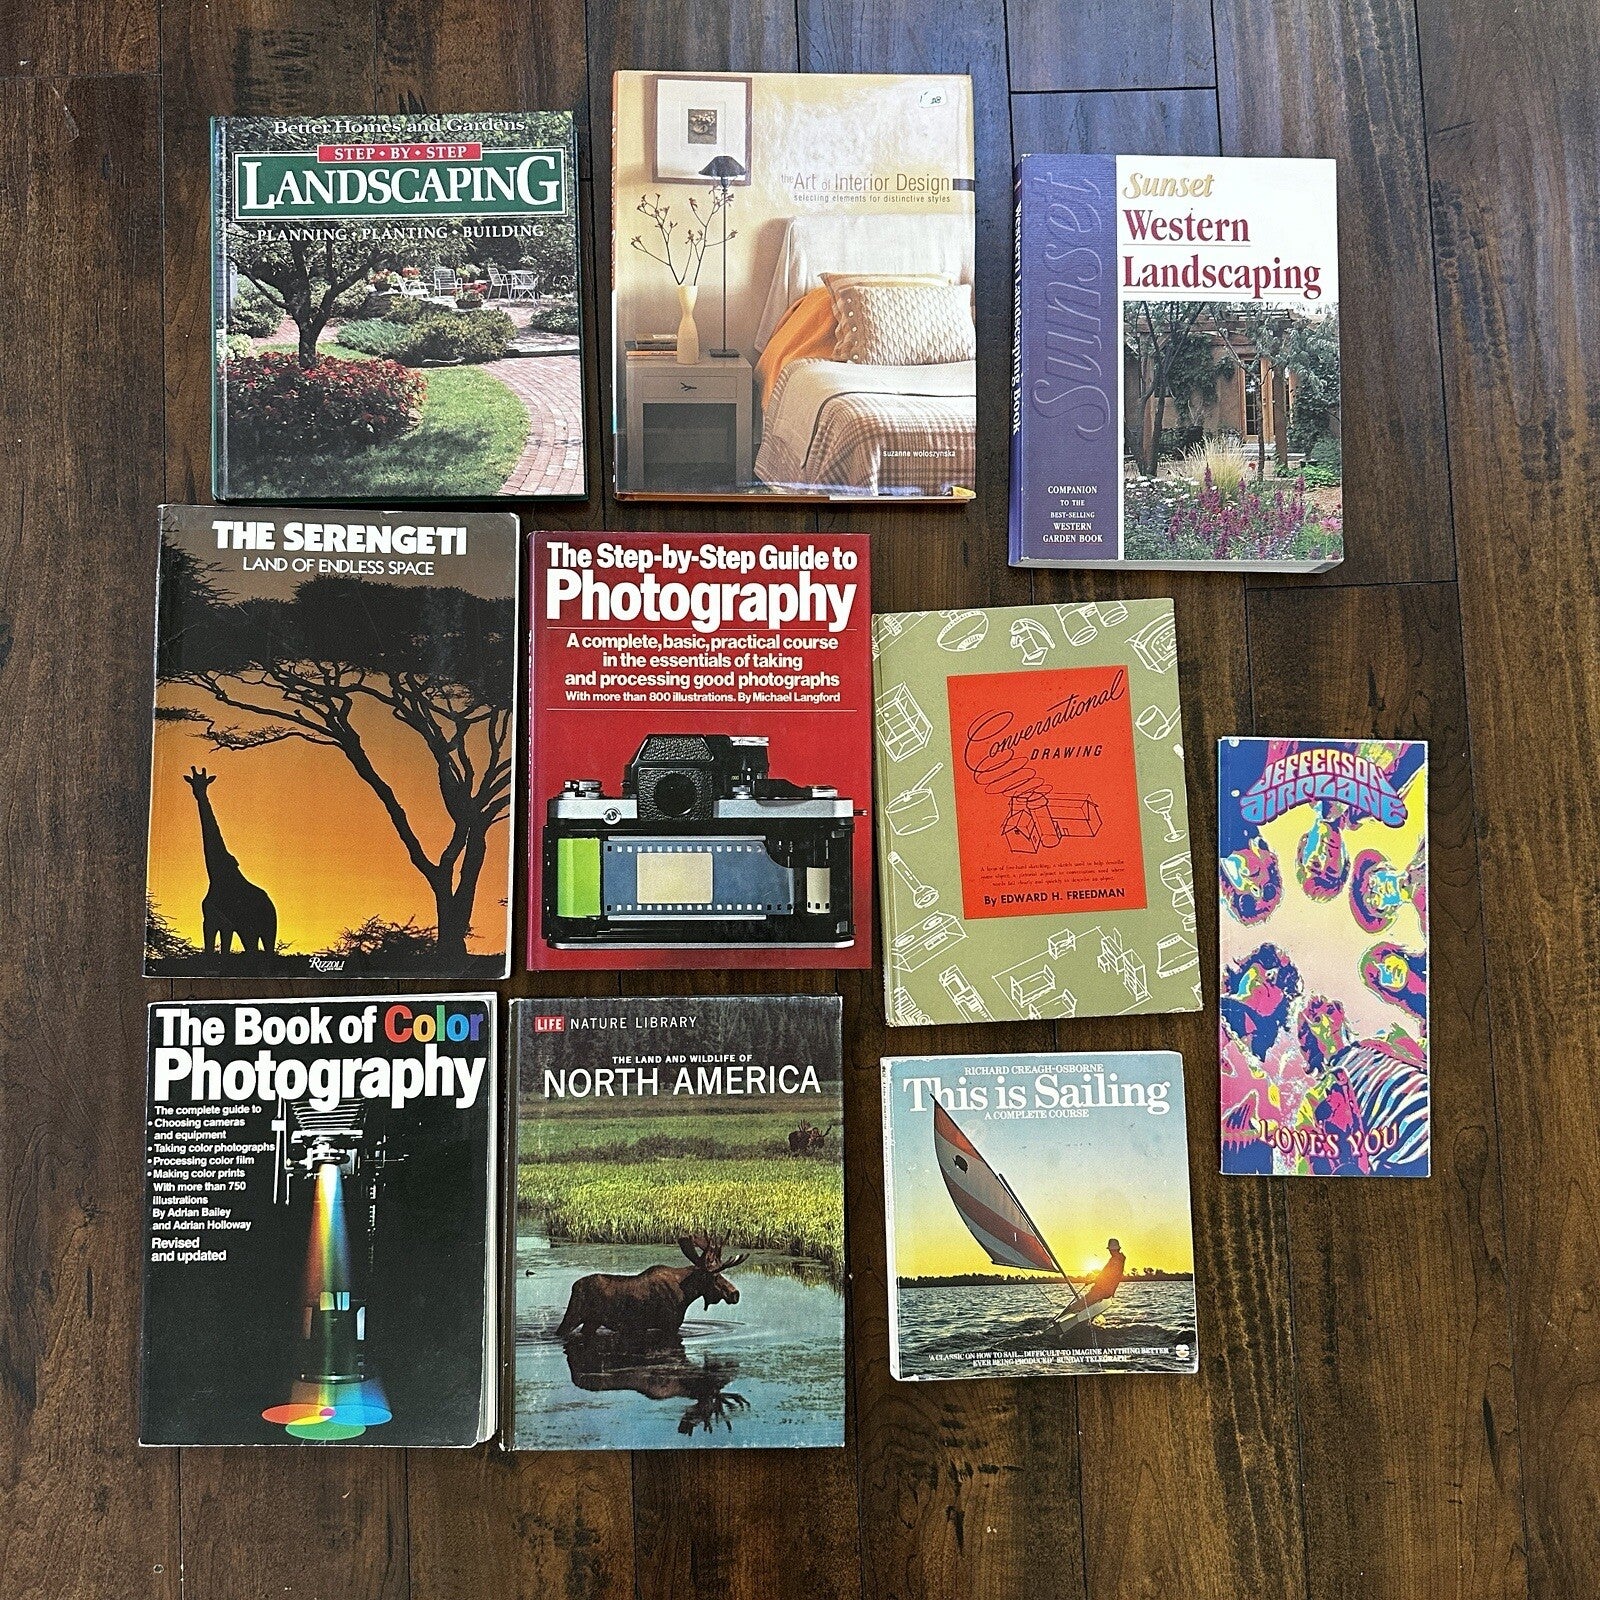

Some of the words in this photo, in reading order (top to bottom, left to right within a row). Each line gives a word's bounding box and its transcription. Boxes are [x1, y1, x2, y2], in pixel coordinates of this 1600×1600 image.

[274, 121, 331, 134] Better
[334, 120, 396, 134] Homes
[399, 120, 443, 133] and
[447, 118, 525, 132] Gardens
[334, 148, 376, 161] STEP
[391, 147, 411, 160] BY
[426, 146, 467, 159] STEP
[241, 156, 560, 210] LANDSCAPING
[781, 175, 794, 183] the
[794, 174, 816, 190] Art
[822, 180, 831, 190] of
[836, 174, 889, 190] Interior
[896, 174, 949, 194] Design
[1122, 173, 1215, 199] Sunset
[794, 195, 829, 203] selecting
[928, 195, 950, 203] styles
[1123, 208, 1250, 242] Western
[257, 229, 348, 241] PLANNING
[362, 228, 448, 240] PLANTING
[463, 225, 544, 238] BUILDING
[1123, 254, 1322, 299] Landscaping
[1048, 486, 1097, 494] COMPANION
[212, 521, 275, 550] THE
[284, 523, 467, 555] SERENGETI
[547, 542, 592, 568] The
[597, 543, 756, 574] Step-by-Step
[759, 545, 829, 570] Guide
[832, 547, 858, 570] to
[243, 557, 288, 571] LAND
[292, 558, 313, 572] OF
[319, 559, 384, 574] ENDLESS
[388, 561, 434, 575] SPACE
[546, 568, 857, 633] Photography
[567, 633, 580, 649] A
[711, 634, 778, 653] practical
[781, 637, 838, 649] course
[603, 653, 618, 667] in
[621, 653, 646, 667] the
[650, 654, 731, 668] essentials
[735, 655, 751, 668] of
[752, 654, 803, 671] taking
[564, 672, 597, 686] and
[600, 673, 690, 689] processing
[694, 674, 735, 690] good
[738, 674, 840, 690] photographs
[566, 691, 591, 702] With
[593, 693, 620, 702] more
[622, 691, 647, 702] than
[649, 692, 671, 702] 800
[672, 692, 736, 703] illustrations.
[738, 693, 751, 704] By
[752, 692, 793, 703] Michael
[794, 692, 840, 704] Langford
[965, 669, 1125, 773] Conversational
[1030, 745, 1103, 760] DRAWING
[1247, 749, 1399, 795] JEFFERSON
[984, 896, 997, 907] By
[1000, 892, 1048, 905] EDWARD
[1052, 892, 1063, 901] H.
[1067, 888, 1125, 900] FREEDMAN
[309, 957, 345, 972] RIZZOLI
[156, 1009, 225, 1046] The
[235, 1007, 333, 1046] Book
[338, 1006, 377, 1044] of
[385, 1004, 483, 1043] Color
[537, 1019, 562, 1030] LIFE
[570, 1017, 627, 1029] NATURE
[636, 1016, 697, 1029] LIBRARY
[612, 1056, 632, 1064] THE
[635, 1056, 662, 1064] LAND
[665, 1055, 686, 1063] AND
[739, 1054, 753, 1062] OF
[154, 1043, 486, 1111] Photography
[964, 1066, 1009, 1076] RICHARD
[1012, 1064, 1104, 1074] CREAGH-OSBORNE
[544, 1067, 658, 1097] NORTH
[673, 1065, 821, 1095] AMERICA
[903, 1076, 988, 1112] This
[996, 1076, 1026, 1110] is
[1034, 1073, 1170, 1114] Sailing
[154, 1106, 173, 1115] The
[176, 1105, 220, 1116] complete
[222, 1105, 250, 1115] guide
[252, 1105, 262, 1113] to
[985, 1112, 992, 1120] A
[994, 1110, 1046, 1120] COMPLETE
[1050, 1109, 1089, 1118] COURSE
[154, 1118, 201, 1128] Choosing
[154, 1131, 173, 1139] and
[175, 1130, 226, 1141] equipment
[1258, 1120, 1339, 1158] LOVES
[1347, 1123, 1399, 1156] YOU
[154, 1144, 186, 1154] Taking
[189, 1144, 212, 1152] color
[214, 1143, 275, 1153] photographs
[153, 1157, 207, 1167] Processing
[209, 1157, 234, 1165] color
[236, 1156, 254, 1164] film
[153, 1169, 189, 1180] Making
[191, 1169, 216, 1178] color
[218, 1169, 245, 1179] prints
[154, 1183, 175, 1191] With
[205, 1182, 226, 1191] than
[228, 1182, 246, 1190] 750
[153, 1196, 208, 1204] illustrations
[153, 1209, 164, 1219] By
[168, 1208, 199, 1217] Adrian
[202, 1208, 231, 1218] Bailey
[153, 1221, 171, 1230] and
[173, 1221, 204, 1230] Adrian
[207, 1221, 251, 1231] Holloway
[152, 1237, 200, 1248] Revised
[152, 1252, 174, 1261] and
[177, 1251, 227, 1263] updated
